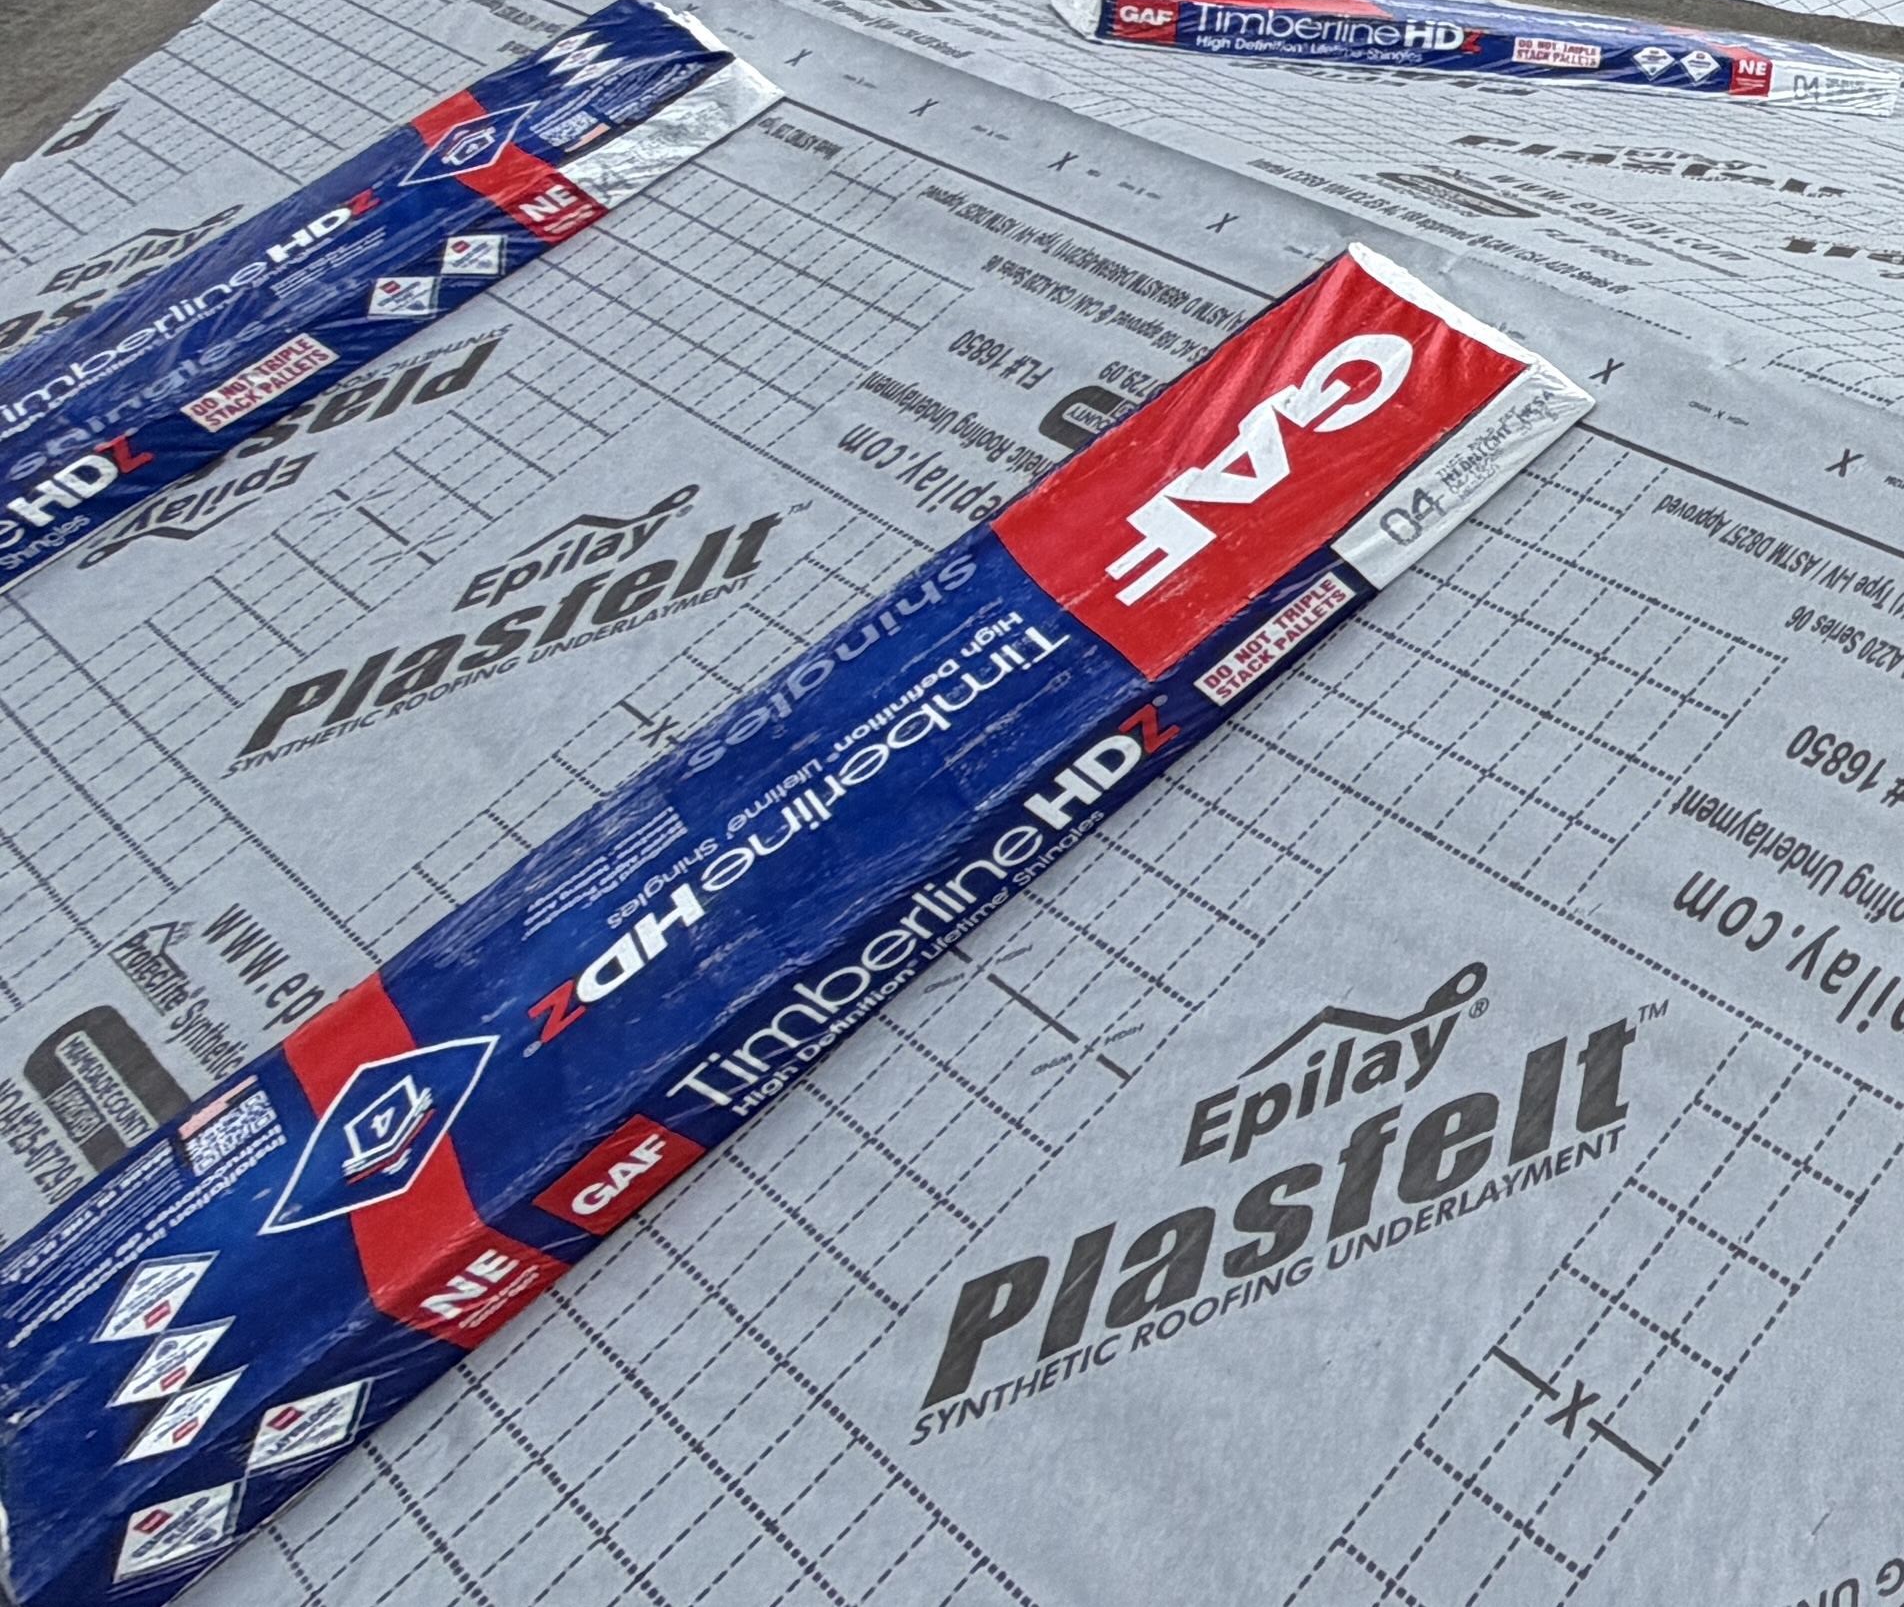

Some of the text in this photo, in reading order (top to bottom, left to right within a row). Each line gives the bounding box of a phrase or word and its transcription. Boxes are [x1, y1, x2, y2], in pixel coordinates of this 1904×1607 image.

[1119, 5, 1174, 26] GAF
[1193, 2, 1401, 46] Timberline
[1739, 60, 1767, 76] NE
[518, 183, 580, 222] NE
[190, 338, 315, 416] DO NOT TRIPLE
[205, 349, 330, 426] STACK PALLETS
[948, 329, 1054, 391] FL# 16850
[1106, 332, 1413, 607] GAF
[1652, 494, 1732, 538] Approved
[1784, 605, 1816, 632] 06
[1853, 574, 1896, 610] Type
[1203, 578, 1337, 690] DO NOT TRIPLE
[1215, 589, 1347, 698] STACK PALLETS
[1811, 614, 1866, 654] Series
[221, 574, 755, 780] SYNTHETIC ROOFING UNDERLAYMENT
[698, 612, 1070, 891] Timberline
[1785, 722, 1889, 797] 16850
[1668, 784, 1847, 898] Underlayment
[666, 817, 1044, 1107] Timberline
[570, 1135, 669, 1218] GAF
[419, 1248, 520, 1322] NE
[908, 1125, 1628, 1446] SYNTHETIC ROOFING UNDERLAYMENT
